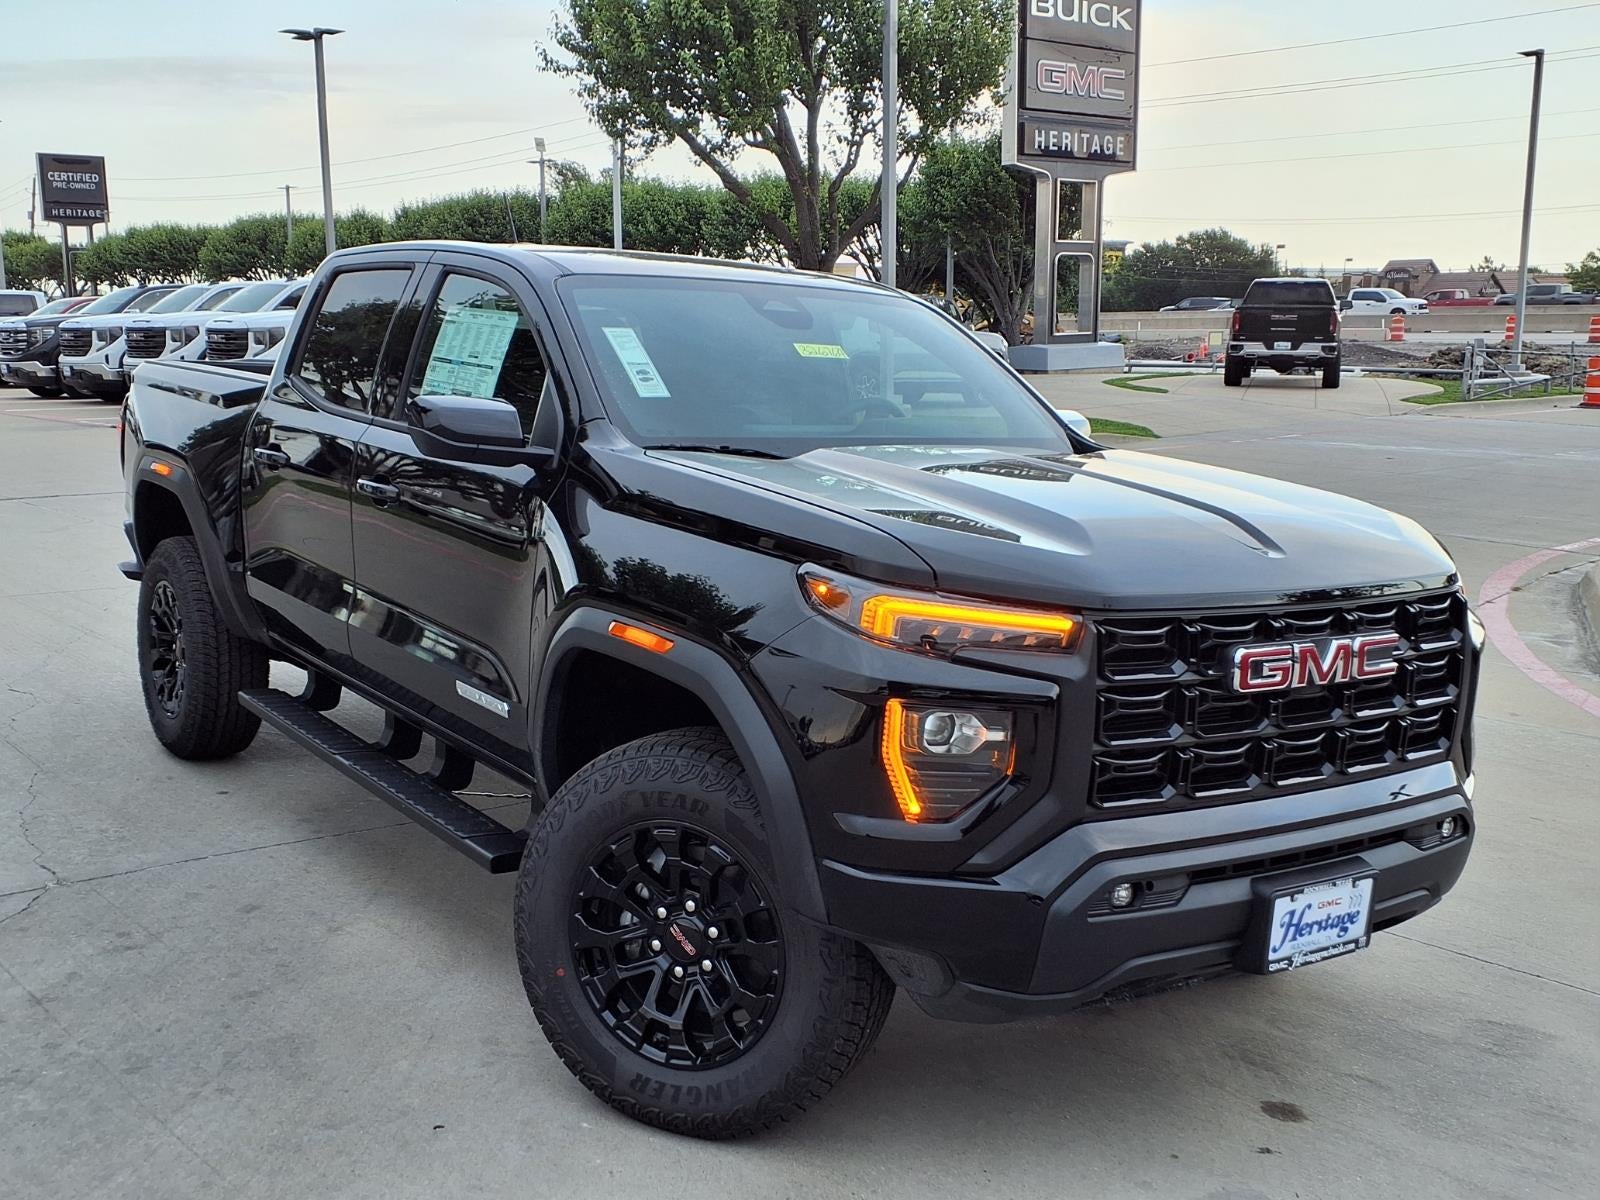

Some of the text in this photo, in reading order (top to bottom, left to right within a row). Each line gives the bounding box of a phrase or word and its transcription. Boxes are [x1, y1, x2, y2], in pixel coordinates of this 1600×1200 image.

[1030, 0, 1133, 31] BUICK
[1037, 59, 1125, 101] GMC
[1034, 129, 1125, 156] HERITAGE
[47, 171, 99, 183] CERTIFIED
[52, 181, 96, 190] PRE-OWNED
[51, 208, 102, 218] HERITAGE
[1233, 633, 1400, 693] GMC
[1317, 897, 1343, 910] GMC
[1271, 903, 1361, 954] Heritage
